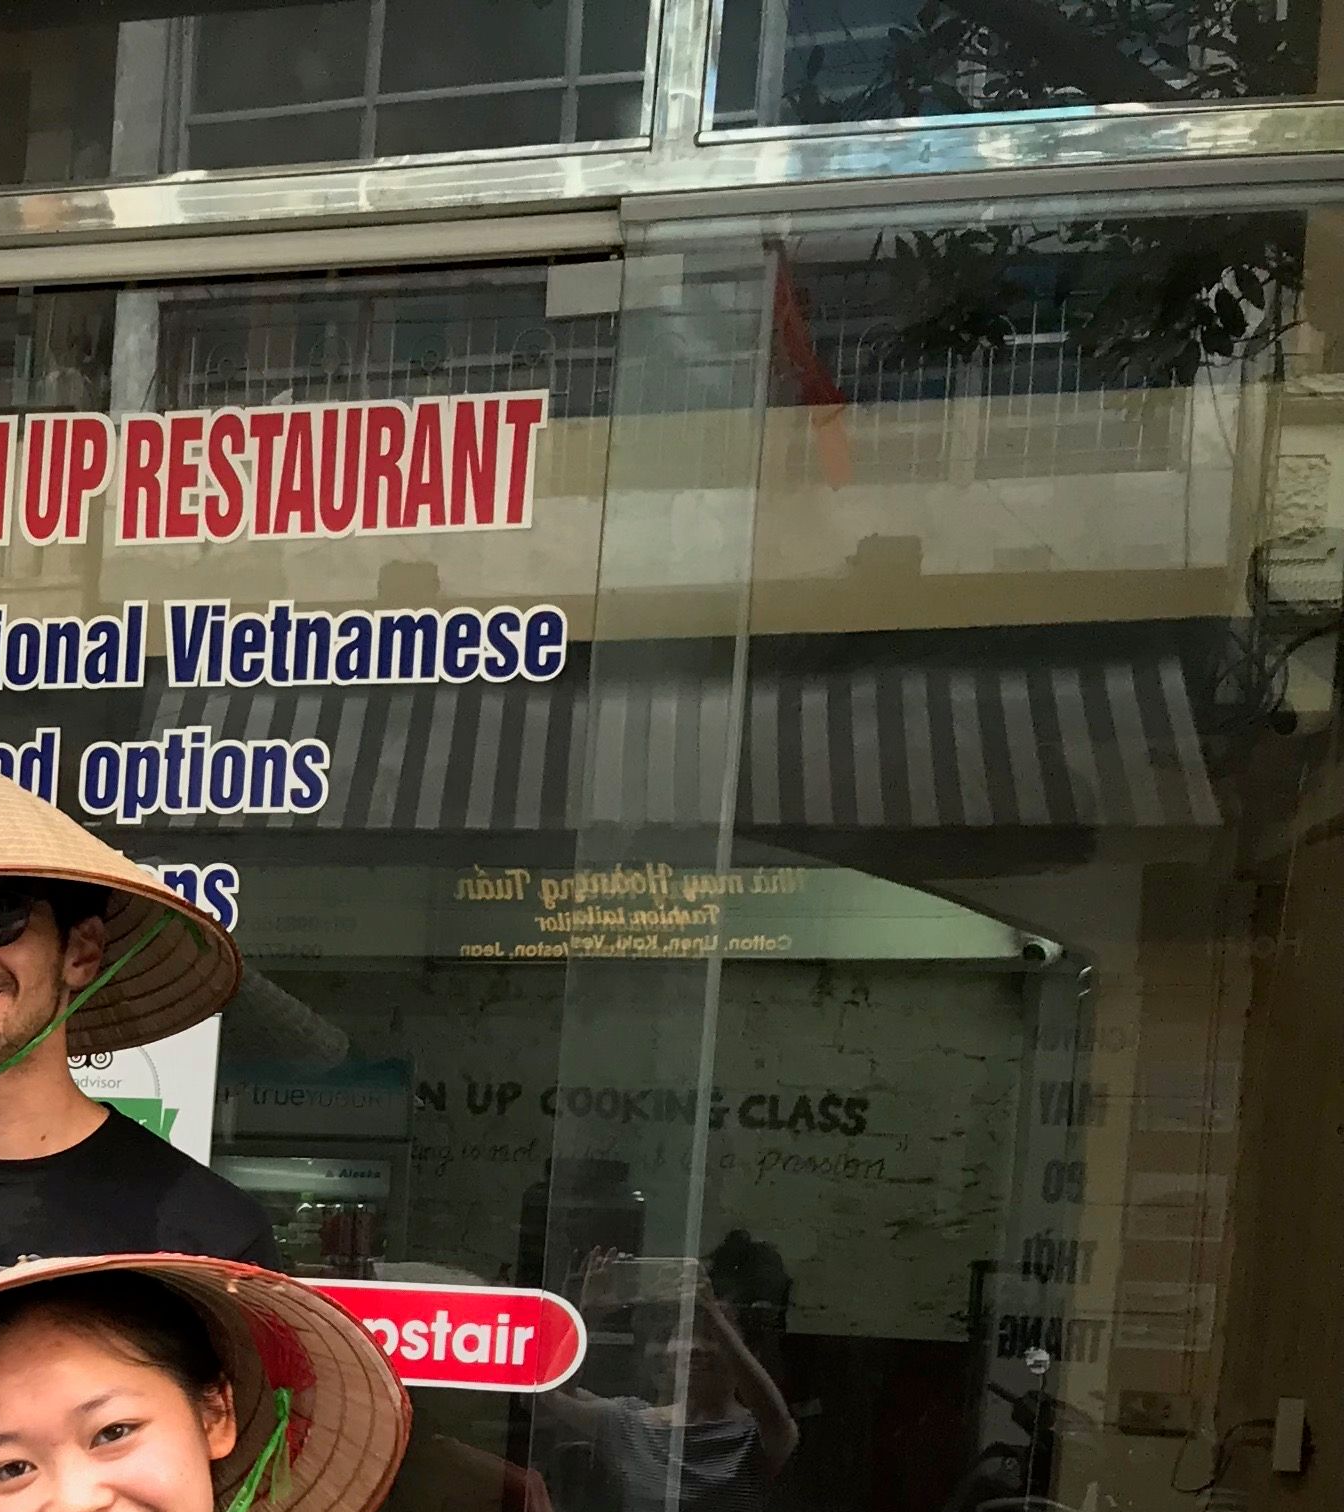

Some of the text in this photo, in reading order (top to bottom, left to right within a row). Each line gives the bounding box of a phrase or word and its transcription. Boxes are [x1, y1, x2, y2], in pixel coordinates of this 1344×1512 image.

[20, 409, 115, 546] UP
[115, 389, 550, 546] RESTAURANT
[162, 598, 568, 688] Vietnamese
[78, 726, 332, 825] options
[737, 1093, 870, 1136] CLASS
[362, 1310, 534, 1366] pstair
